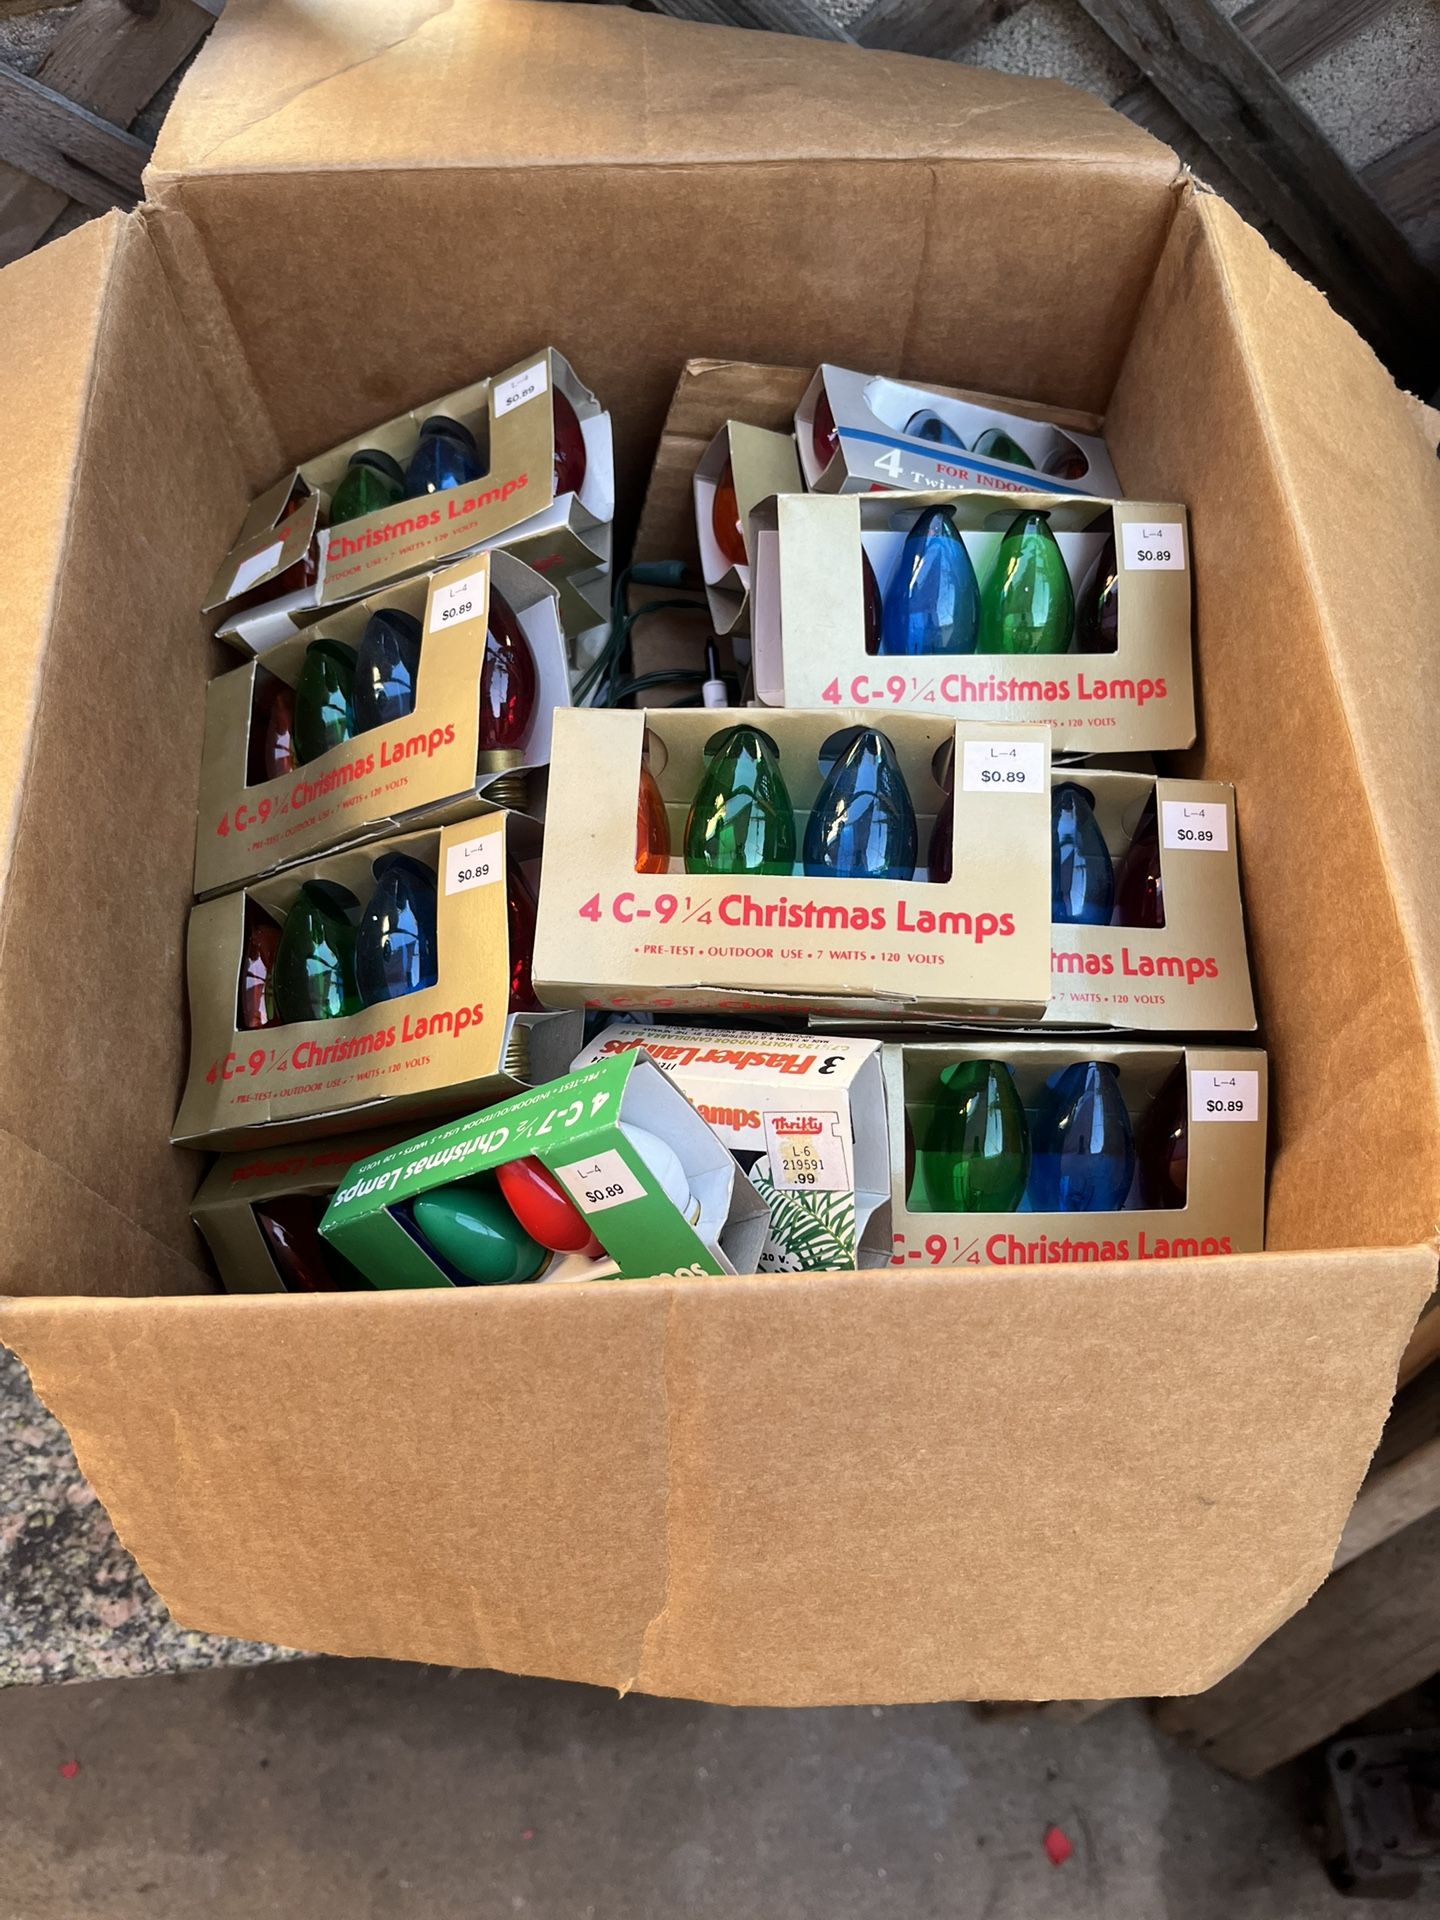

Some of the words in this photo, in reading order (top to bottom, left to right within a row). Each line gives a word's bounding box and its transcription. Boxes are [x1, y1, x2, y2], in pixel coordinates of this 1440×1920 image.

[505, 385, 535, 406] $0.89
[873, 448, 904, 479] 4
[936, 463, 969, 481] FOR
[976, 472, 1035, 493] INDOO
[326, 507, 442, 563] Christmas
[447, 472, 529, 521] Lamps
[400, 541, 426, 556] WATTS
[453, 520, 479, 536] VOLTS
[1137, 549, 1171, 563] $0.89
[442, 601, 473, 621] $0.89
[821, 676, 842, 705] 4
[940, 674, 1070, 703] Christmas
[1078, 672, 1168, 706] Lamps
[1067, 718, 1083, 727] 120
[1087, 717, 1116, 727] VOLTS
[216, 812, 231, 838] 4
[290, 753, 375, 810] Christmas
[379, 722, 456, 769] Lamps
[385, 776, 409, 792] VOLTS
[980, 769, 1026, 784] $0.89
[1183, 807, 1205, 819] L-4
[1177, 828, 1214, 843] $0.89
[464, 842, 484, 858] L-4
[457, 864, 490, 883] $0.89
[578, 892, 602, 922] 4
[718, 894, 887, 931] Christmas
[897, 900, 1016, 944] Lamps
[643, 944, 696, 956] PRE-TEST
[707, 946, 774, 959] OUTDOOR
[780, 948, 804, 960] USE
[829, 950, 867, 961] WATTS
[880, 952, 901, 963] 120
[907, 953, 945, 965] VOLTS
[1121, 947, 1219, 985] Lamps
[1070, 992, 1102, 1003] WATTS
[1112, 994, 1129, 1004] 120
[1134, 994, 1165, 1005] VOLTS
[291, 1025, 396, 1070] Christmas
[401, 1003, 484, 1042] Lamps
[713, 1036, 758, 1046] INDOOR
[761, 1040, 794, 1048] VOLTS
[694, 1048, 818, 1075] Flasher
[818, 1055, 846, 1075] 3
[280, 1081, 323, 1098] OUTDOOR
[326, 1077, 344, 1090] USE
[356, 1067, 381, 1082] WATTS
[387, 1062, 402, 1075] 120
[405, 1055, 431, 1069] VOLTS
[558, 1070, 601, 1094] PRE-TEST
[1213, 1077, 1236, 1088] L-4
[461, 1089, 551, 1132] INDOOR/OUTDOOR
[590, 1091, 610, 1118] 4
[1206, 1099, 1243, 1114] $0.89
[696, 1104, 761, 1131] amps
[771, 1116, 823, 1135] Thrifty
[444, 1126, 460, 1139] USE
[403, 1140, 428, 1156] WATTS
[403, 1126, 510, 1180] Christmas
[357, 1159, 382, 1175] VOLTS
[577, 1164, 602, 1179] L-4
[782, 1159, 824, 1171] 219591
[333, 1166, 405, 1208] Lamps
[794, 1173, 816, 1184] .99
[585, 1183, 624, 1203] $0.89
[759, 1252, 775, 1262] 20
[985, 1233, 1129, 1265] Christmas
